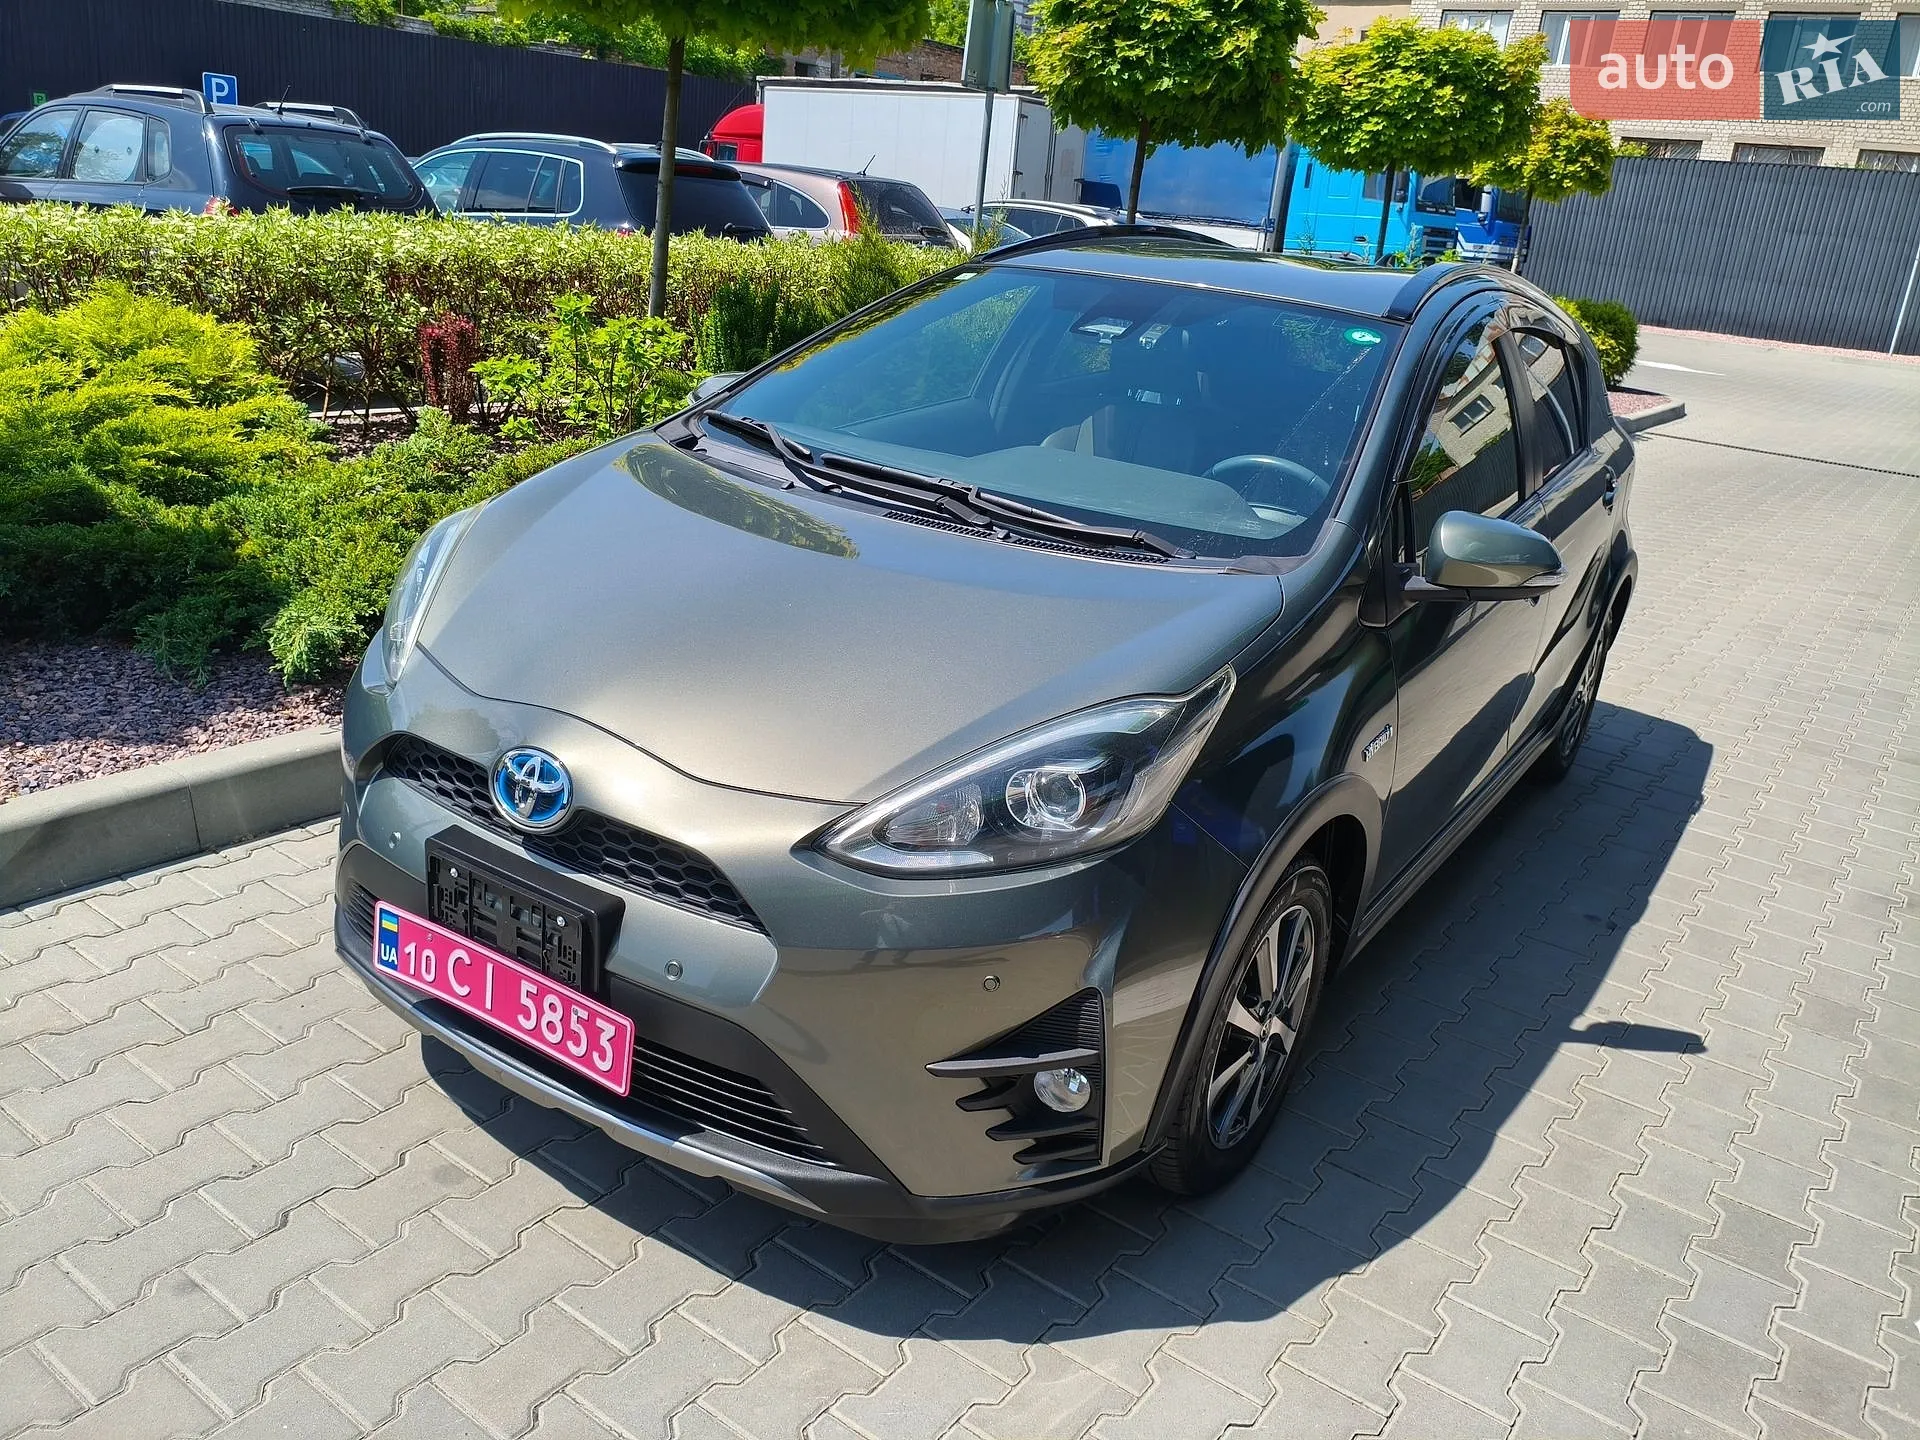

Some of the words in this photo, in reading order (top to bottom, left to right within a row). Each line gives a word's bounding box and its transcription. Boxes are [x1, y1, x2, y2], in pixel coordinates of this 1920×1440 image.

[211, 77, 229, 104] P
[380, 943, 398, 965] UA
[404, 941, 437, 983] 10
[517, 979, 617, 1073] 5853
